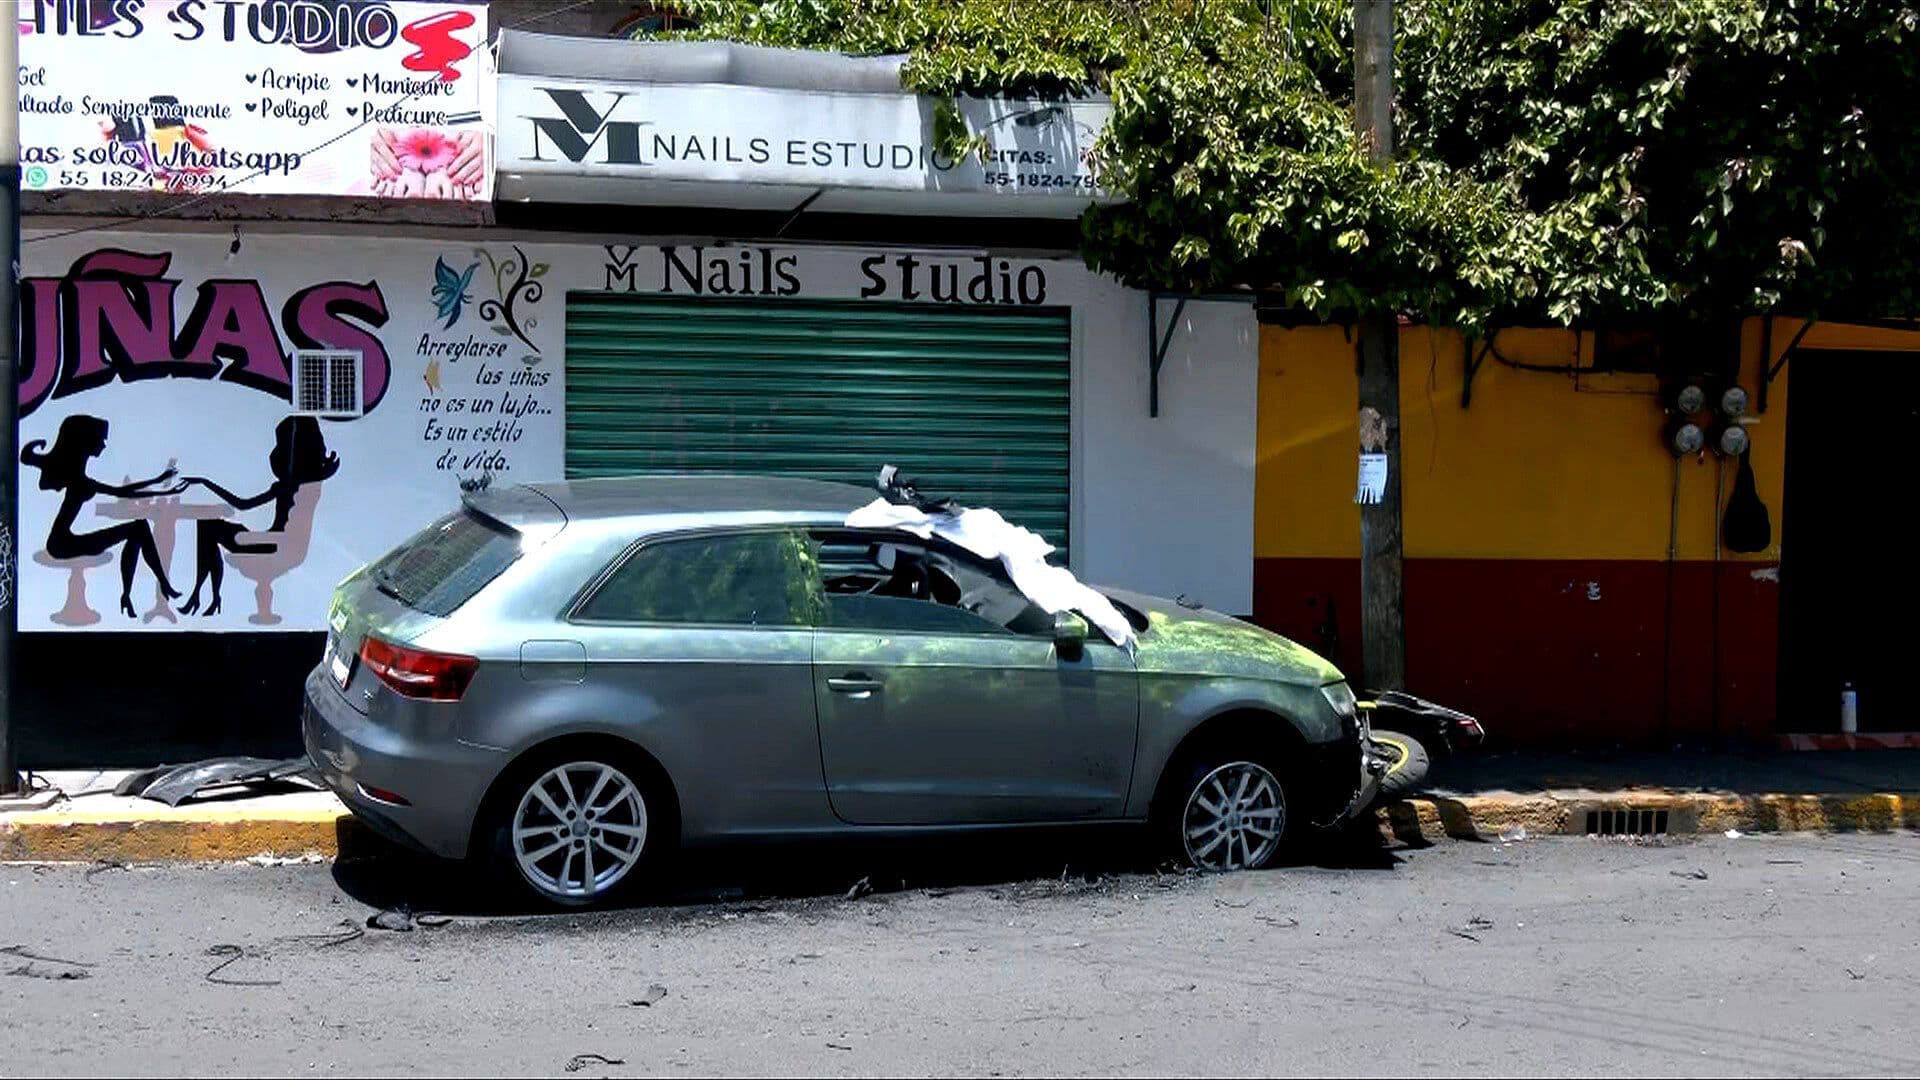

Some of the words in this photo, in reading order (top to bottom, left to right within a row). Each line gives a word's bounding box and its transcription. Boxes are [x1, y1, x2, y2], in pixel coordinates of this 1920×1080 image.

[167, 0, 398, 49] STUDIO
[18, 64, 46, 87] Gel
[362, 72, 456, 97] Manicure
[81, 94, 232, 120] Semipermanente
[261, 96, 330, 127] Poligel
[362, 101, 449, 126] Pedicure
[72, 137, 139, 166] solo
[151, 139, 301, 176] Whatsapp
[653, 132, 772, 165] NAILS
[59, 169, 89, 186] 55
[102, 170, 154, 188] 1824
[167, 171, 228, 190] 7994
[659, 246, 801, 297] Nails
[416, 332, 508, 363] Arreglarse
[475, 363, 503, 385] las
[509, 366, 551, 387] uñas
[419, 398, 441, 412] no
[445, 398, 466, 413] es
[470, 399, 494, 414] un
[499, 391, 552, 419] lujo...
[424, 417, 443, 441] Es
[446, 426, 468, 441] un
[472, 419, 523, 442] estilo
[435, 447, 457, 470] de
[462, 448, 511, 471] vida.
